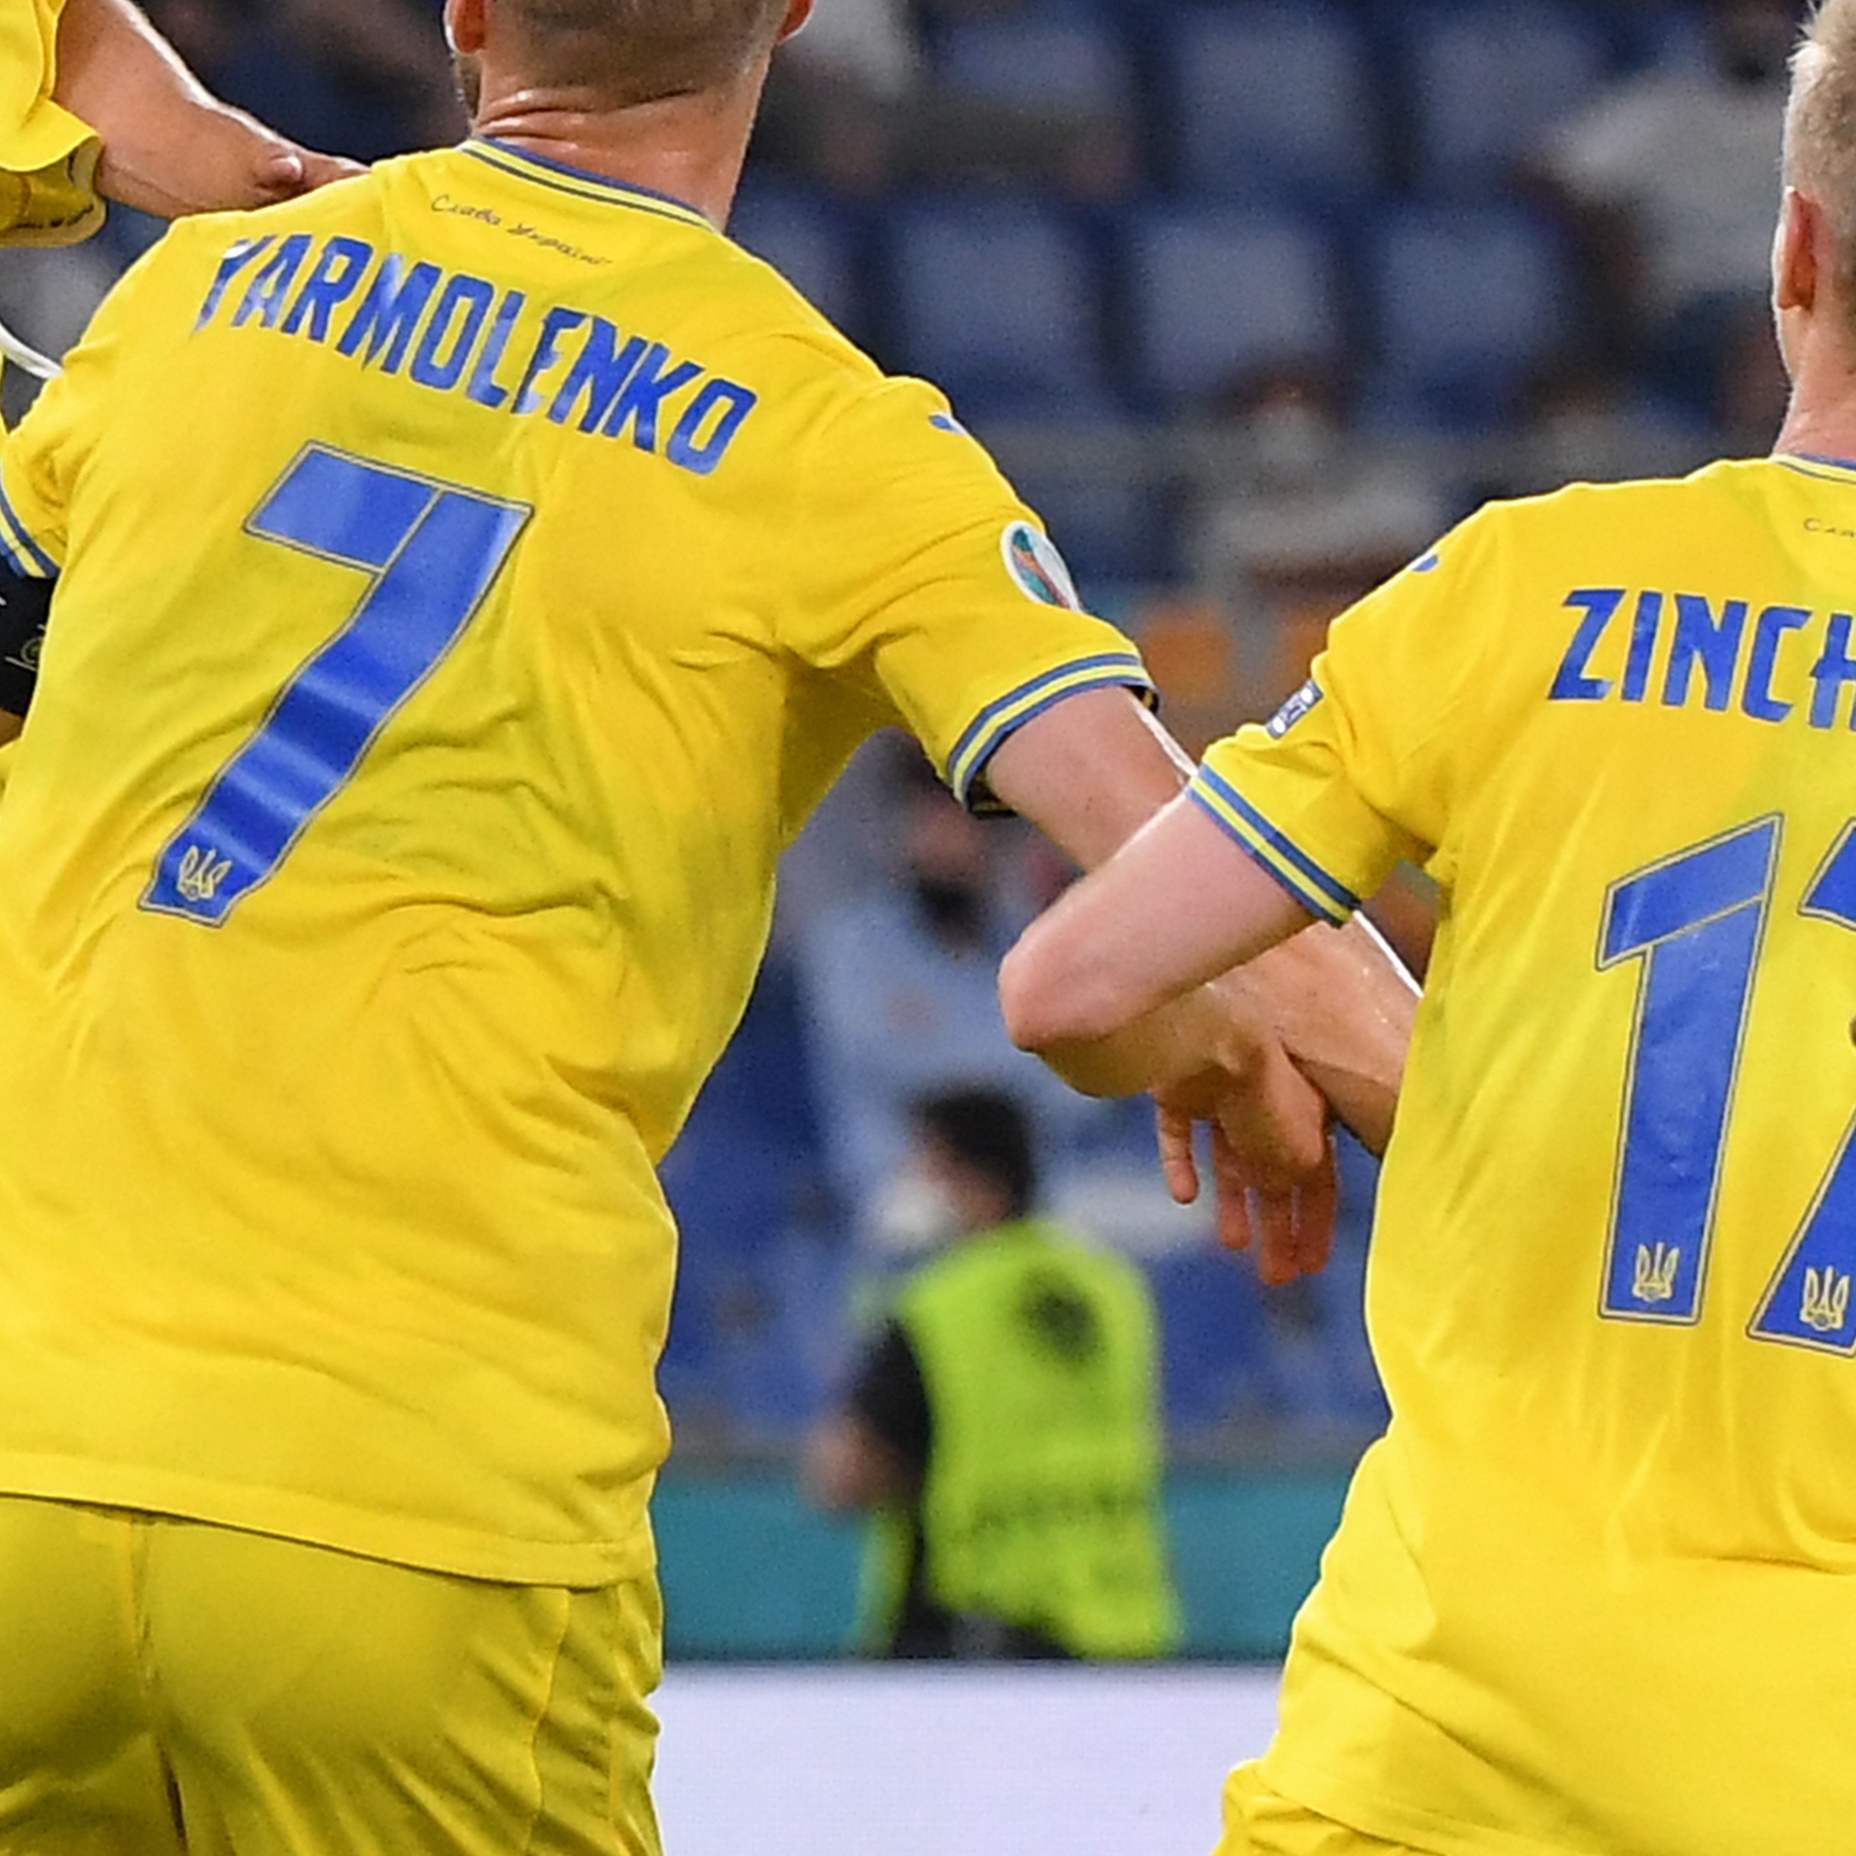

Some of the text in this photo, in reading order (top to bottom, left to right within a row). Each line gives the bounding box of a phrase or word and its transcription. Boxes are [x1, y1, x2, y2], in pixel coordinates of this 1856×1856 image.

[192, 231, 758, 477] YARMOLENKO
[136, 438, 536, 928] 7
[1547, 587, 1856, 732] ZINCH
